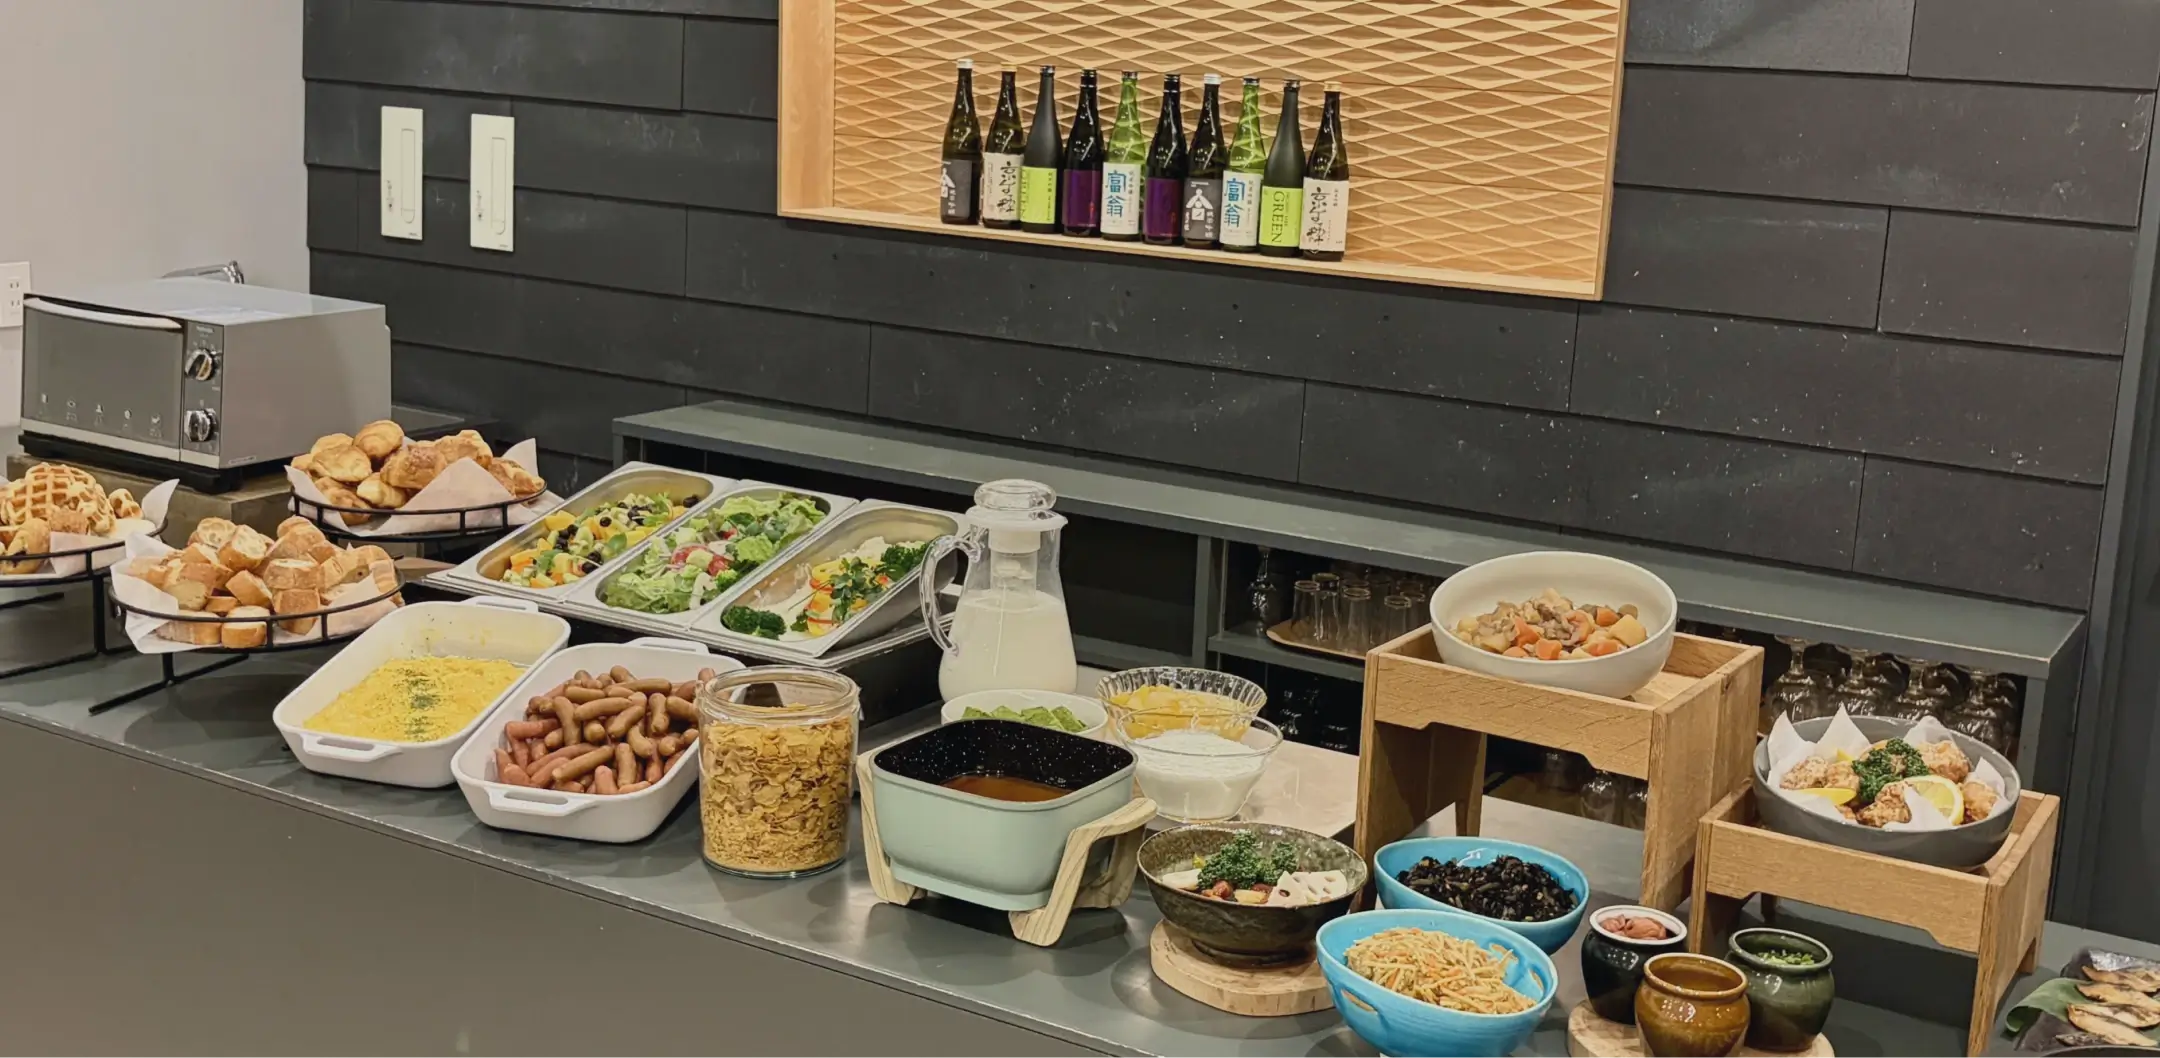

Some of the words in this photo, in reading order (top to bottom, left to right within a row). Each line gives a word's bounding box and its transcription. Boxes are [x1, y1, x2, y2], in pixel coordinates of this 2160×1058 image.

[1105, 169, 1127, 218] 富翁
[1224, 177, 1245, 228] 富翁
[1271, 190, 1286, 243] GREEN
